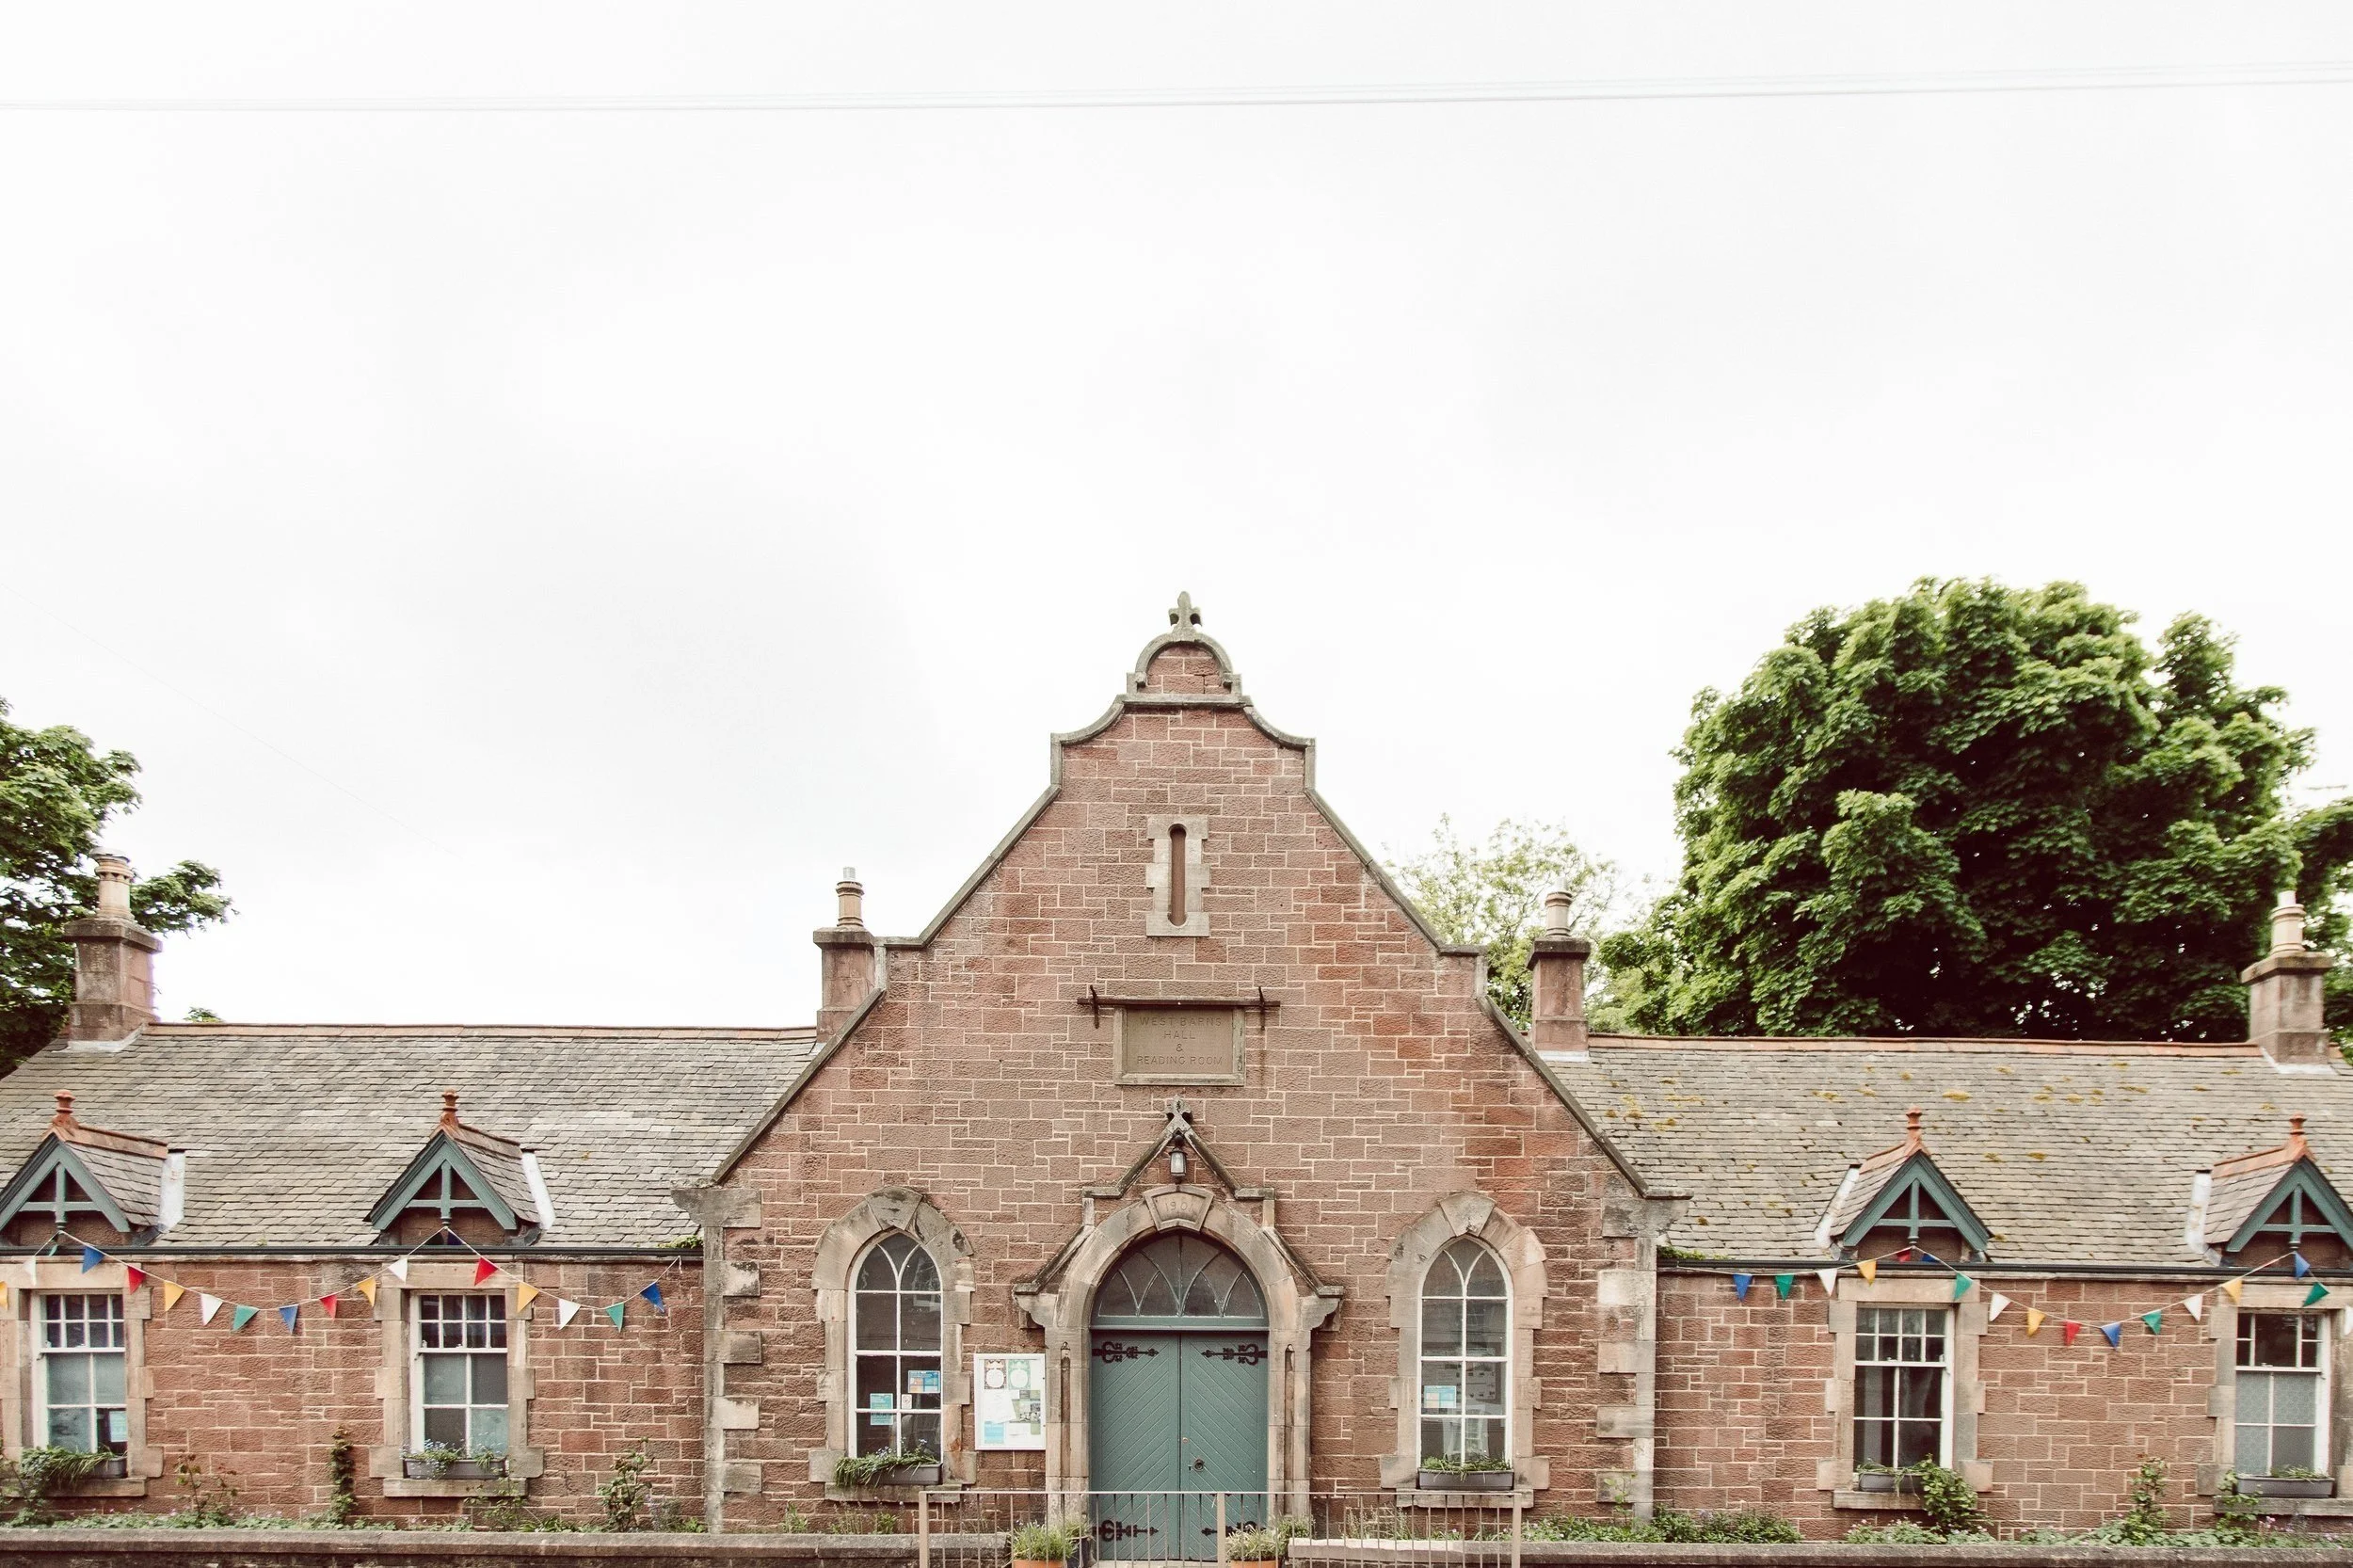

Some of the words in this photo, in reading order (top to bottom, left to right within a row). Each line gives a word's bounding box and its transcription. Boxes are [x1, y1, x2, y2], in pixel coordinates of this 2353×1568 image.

[1140, 1017, 1176, 1027] WEST
[1180, 1017, 1222, 1027] BARNS
[1163, 1031, 1195, 1040] HALL
[1137, 1056, 1185, 1065] READING
[1190, 1056, 1223, 1065] ROOM
[1165, 1201, 1193, 1212] 1901
